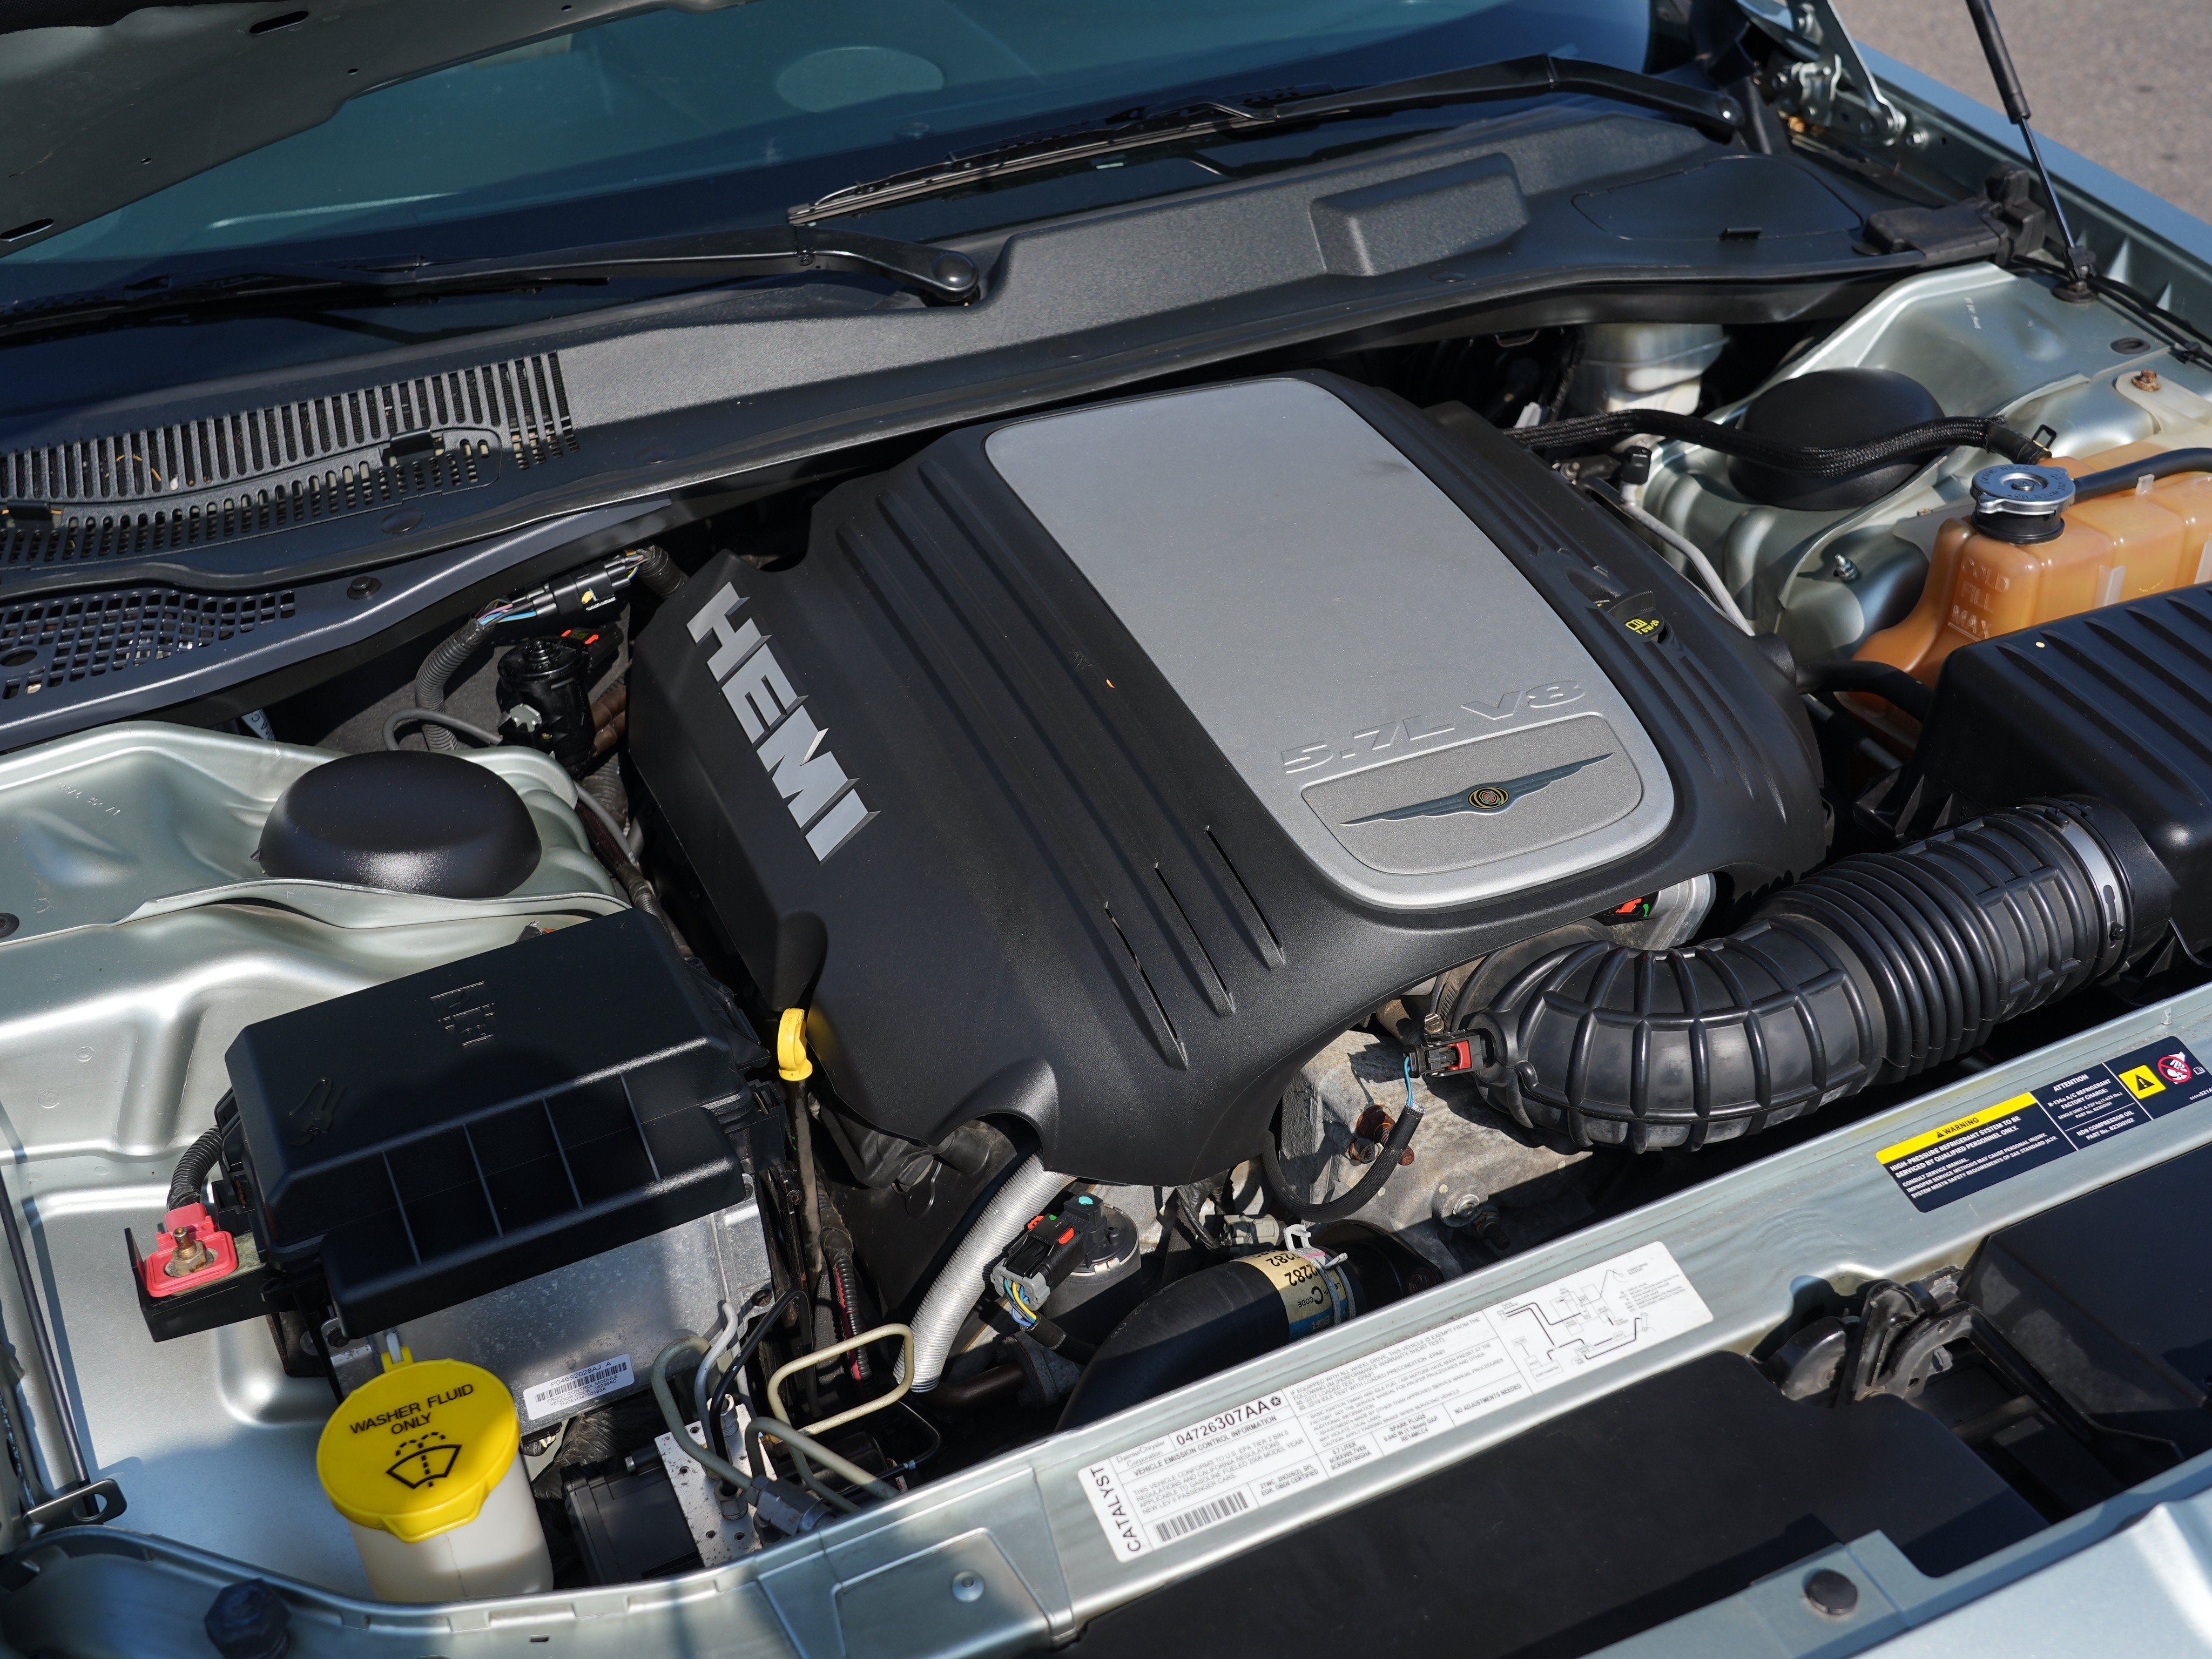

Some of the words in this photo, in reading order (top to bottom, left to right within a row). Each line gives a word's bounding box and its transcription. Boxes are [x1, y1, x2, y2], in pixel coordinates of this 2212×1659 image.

[1961, 558, 2011, 592] COLD
[1961, 581, 1994, 613] FILL
[1951, 605, 1992, 639] MAX
[686, 581, 880, 866] HEMI
[1281, 714, 1455, 774] 5.7L
[1460, 680, 1586, 720] V8
[2047, 1098, 2067, 1107] R-134a
[2075, 1078, 2111, 1096] REFRIGERANT
[2053, 1074, 2089, 1091] ATTENTION
[2060, 1096, 2085, 1109] FACTORY
[2084, 1088, 2108, 1100] CHARGE:
[1942, 1117, 1979, 1135] WARNING
[2086, 1131, 2101, 1140] PART
[2108, 1117, 2135, 1130] 82300102
[2088, 1114, 2125, 1131] COMPRESSOR
[1889, 1148, 1940, 1171] HIGH-PRESSURE
[1938, 1131, 1980, 1151] REFRIGERANT
[1979, 1122, 2004, 1135] SYSTEM
[1895, 1162, 1926, 1178] SERVICED
[1934, 1145, 1967, 1162] QUALIFIED
[1965, 1132, 2002, 1149] PERSONNEL
[2000, 1125, 2019, 1135] ONLY.
[1902, 1174, 1926, 1187] CONSULT
[1925, 1166, 1947, 1177] SERVICE
[1945, 1157, 1970, 1169] MANUAL.
[1906, 1179, 1934, 1192] IMPROPER
[1932, 1170, 1954, 1182] SERVICE
[1952, 1161, 1978, 1173] METHODS
[1987, 1150, 2005, 1159] CAUSE
[2003, 1140, 2029, 1152] PERSONAL
[2028, 1132, 2047, 1143] INJURY.
[1911, 1187, 1932, 1198] SYSTEM
[1930, 1180, 1949, 1190] MEETS
[1947, 1172, 1966, 1183] SAFETY
[1965, 1157, 2004, 1175] REQUIREMENTS
[2019, 1141, 2046, 1154] STANDARD
[1284, 1265, 1318, 1286] 2282
[1298, 1297, 1314, 1307] CODE
[1311, 1286, 1323, 1305] C
[1296, 1379, 1325, 1393] EQUIPPED
[1325, 1373, 1340, 1382] WITH
[1350, 1361, 1370, 1372] WHEEL
[1388, 1348, 1401, 1356] THIS
[1401, 1339, 1425, 1351] VEHICLE
[1431, 1327, 1452, 1340] EXEMPT
[1453, 1321, 1469, 1331] FROM
[551, 1365, 601, 1386] P04692028AJ
[1292, 1384, 1326, 1401] FOLLOWING
[1335, 1363, 1378, 1385] (PERFORMANCE
[1378, 1351, 1408, 1366] WARRANTY
[1409, 1343, 1427, 1354] SHORT
[547, 1394, 566, 1403] FRONT
[568, 1384, 594, 1395] CONTROL
[595, 1374, 618, 1385] MODULE
[550, 1396, 574, 1406] VENDOR
[1317, 1384, 1341, 1397] LOADED
[1340, 1378, 1355, 1387] TEST
[1464, 1392, 1500, 1411] ADJUSTMENTS
[1500, 1383, 1521, 1395] NEEDED
[350, 1402, 421, 1434] WASHER
[427, 1384, 474, 1408] FLUID
[391, 1412, 431, 1434] ONLY
[1176, 1400, 1270, 1445] 04726307AA
[1390, 1420, 1408, 1432] SPARK
[1407, 1413, 1426, 1424] PLUGS
[1116, 1440, 1165, 1463] DaimlerChrysler
[1127, 1451, 1163, 1467] Corporation
[1134, 1460, 1163, 1476] VEHICLE
[1164, 1447, 1197, 1464] EMISSION
[1197, 1434, 1231, 1451] CONTROL
[1230, 1415, 1277, 1438] INFORMATION
[1340, 1441, 1357, 1451] LITER
[1133, 1486, 1149, 1495] THIS
[1149, 1474, 1177, 1489] VEHICLE
[1177, 1459, 1215, 1478] CONFORMS
[1238, 1444, 1252, 1453] EPA
[1252, 1438, 1267, 1447] TIER
[1272, 1431, 1284, 1440] BIN
[1136, 1480, 1182, 1502] REGULATIONS
[1183, 1474, 1197, 1483] AND
[1197, 1459, 1236, 1477] CALIFORNIA
[1235, 1440, 1280, 1462] REGULATIONS
[1140, 1488, 1178, 1508] APPLICABLE
[1189, 1471, 1222, 1487] GASOLINE
[1222, 1460, 1247, 1474] FUELED
[1247, 1454, 1263, 1464] 2006
[1263, 1446, 1286, 1458] MODEL
[1285, 1438, 1304, 1448] YEAR
[1291, 1468, 1318, 1483] CERTIFIED
[1090, 1468, 1141, 1551] CATALYST
[1142, 1503, 1157, 1514] NEW
[1158, 1498, 1171, 1508] LEV
[1177, 1480, 1217, 1500] PASSENGER
